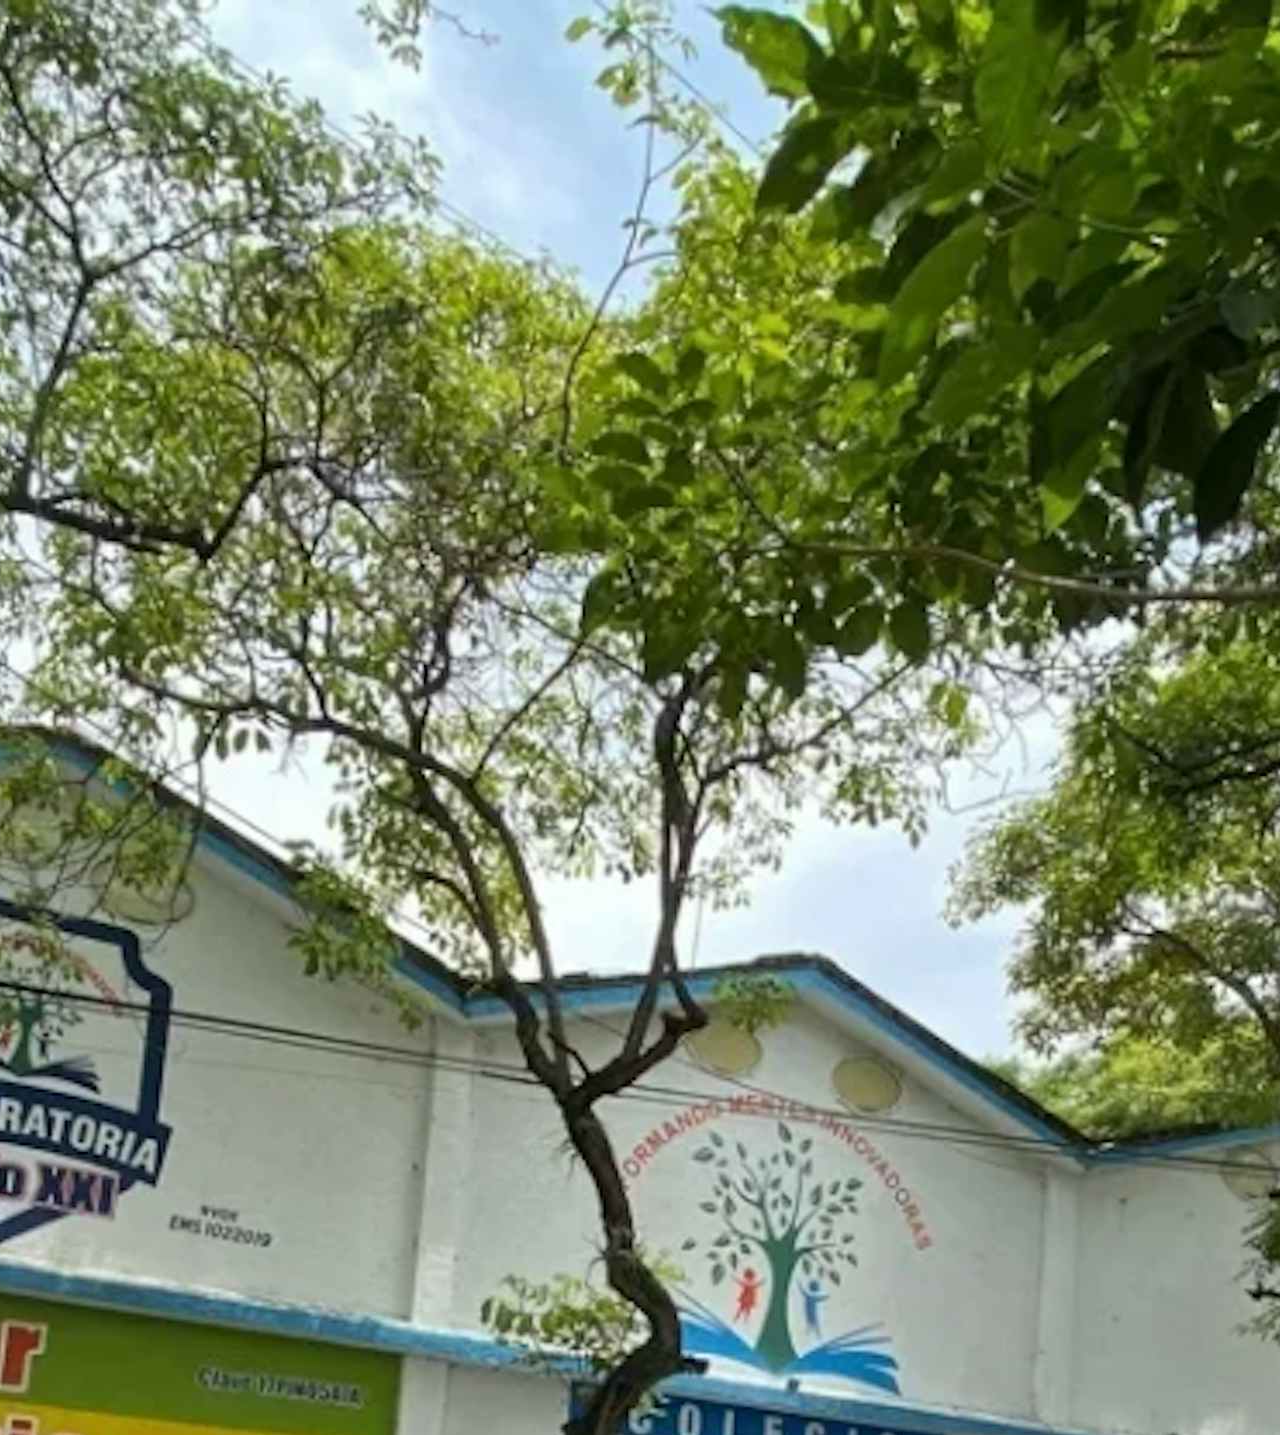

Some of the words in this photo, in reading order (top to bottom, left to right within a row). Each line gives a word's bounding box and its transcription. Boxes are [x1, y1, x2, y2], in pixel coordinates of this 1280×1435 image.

[36, 1163, 118, 1217] XXI
[621, 1101, 721, 1190] ORMANDO
[820, 1116, 931, 1251] INNOVADORAS
